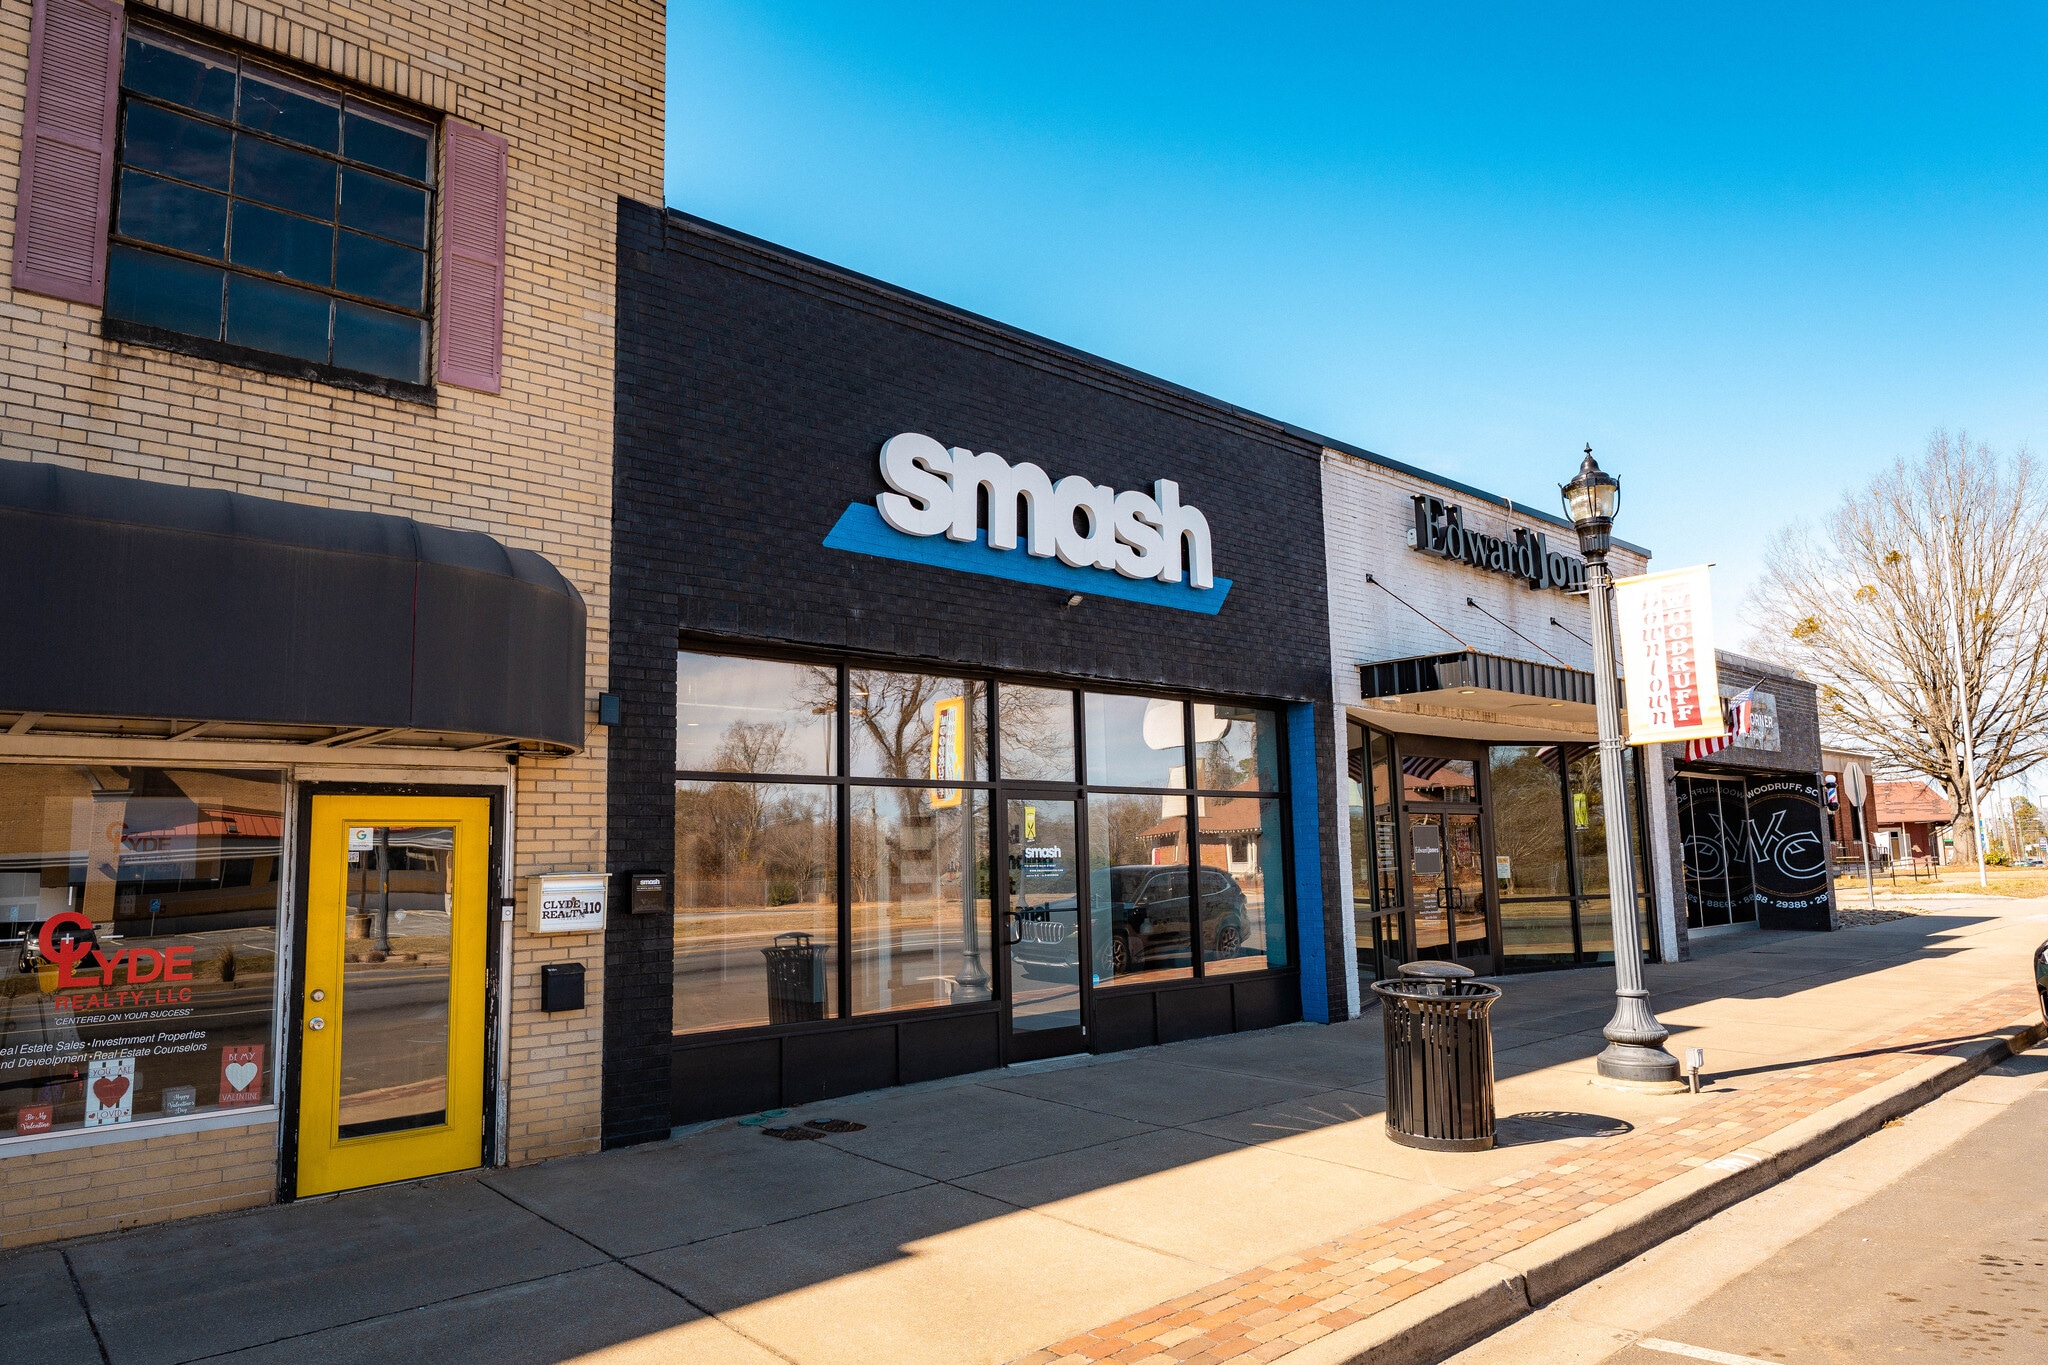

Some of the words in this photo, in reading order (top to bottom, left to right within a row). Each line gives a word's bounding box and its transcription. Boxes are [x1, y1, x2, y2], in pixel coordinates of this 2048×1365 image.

[876, 432, 1214, 590] smash
[1410, 494, 1537, 581] Edward
[1530, 532, 1590, 592] Jon
[1662, 592, 1694, 722] WOODRUFF
[1750, 713, 1774, 729] ORNER
[1804, 786, 1819, 797] SC
[1024, 845, 1062, 859] smash
[543, 899, 581, 909] CLYDE
[583, 901, 602, 915] 110
[1776, 899, 1808, 909] 29388
[541, 909, 585, 919] REALTY
[38, 911, 194, 988] CLYDE
[55, 990, 149, 1011] REALTY,
[155, 987, 192, 1004] LLC
[108, 1013, 122, 1022] ON
[124, 1011, 148, 1020] YOUR
[0, 1045, 18, 1057] eal
[20, 1043, 53, 1054] Estate
[56, 1040, 86, 1051] Sales
[157, 1029, 206, 1043] Properties
[0, 1058, 16, 1069] nd
[18, 1052, 88, 1069] Deveolpment
[93, 1049, 118, 1060] Real
[120, 1047, 151, 1058] Estate
[153, 1042, 208, 1055] Counselors
[228, 1053, 238, 1061] BE
[240, 1051, 256, 1061] MY
[92, 1068, 112, 1077] YOU
[117, 1066, 131, 1075] ARE
[221, 1092, 258, 1101] VALENTINE
[96, 1110, 123, 1120] LOVED
[20, 1121, 51, 1131] Valentine
